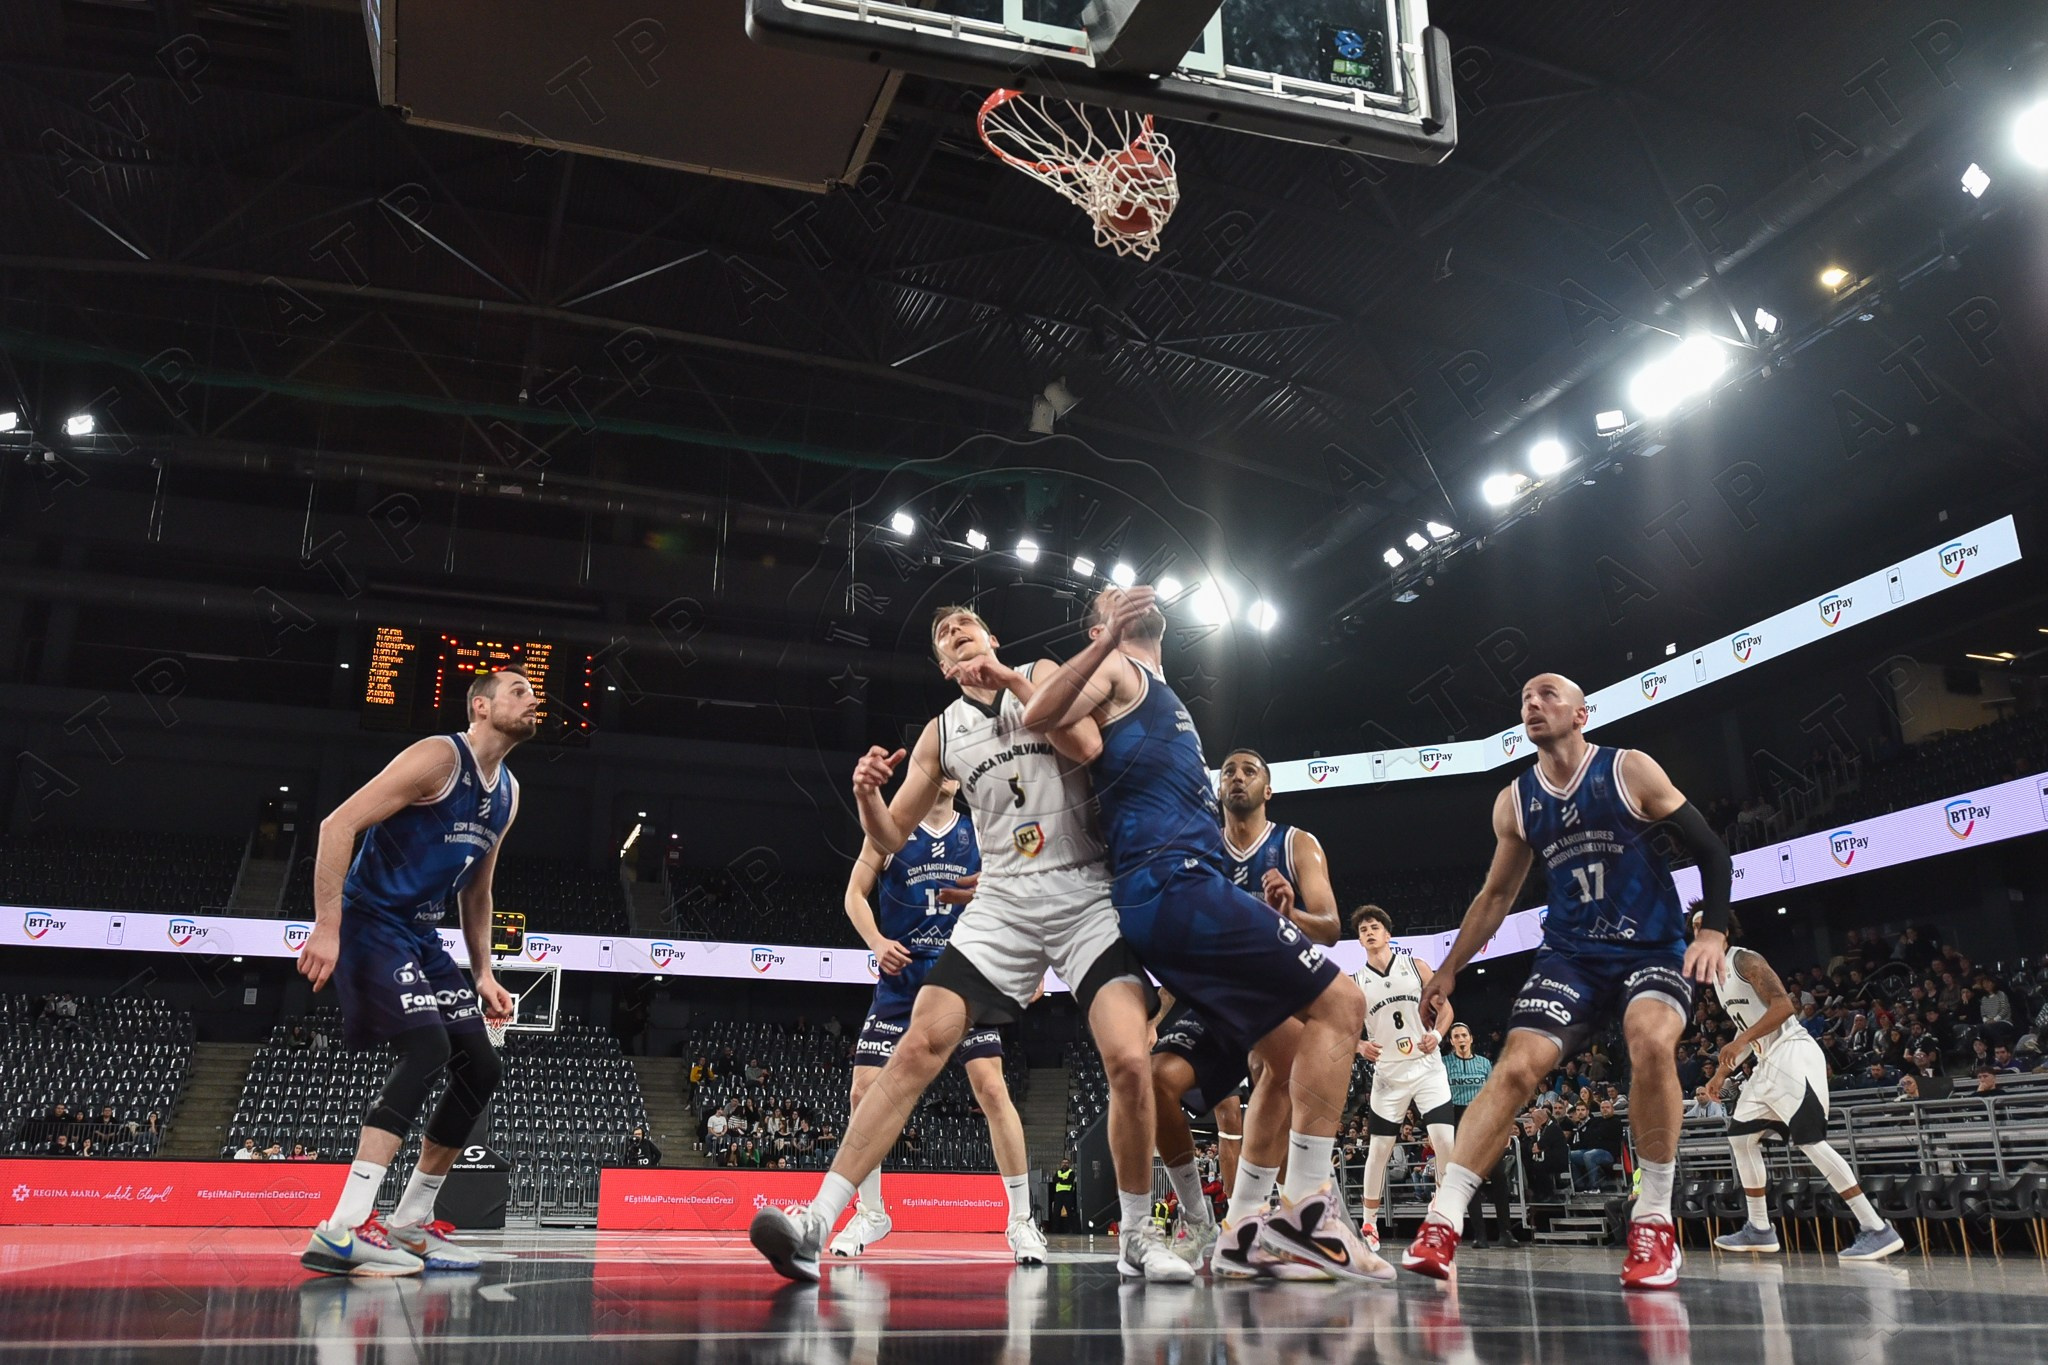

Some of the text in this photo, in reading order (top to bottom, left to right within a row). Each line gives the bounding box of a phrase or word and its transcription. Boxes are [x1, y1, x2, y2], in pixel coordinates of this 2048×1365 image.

[1330, 73, 1376, 90] EuroCup
[1585, 704, 1598, 714] Pay
[1018, 829, 1038, 846] BT
[907, 866, 922, 876] CSM
[1571, 862, 1605, 903] 17
[1392, 1010, 1404, 1030] 8
[32, 1188, 68, 1198] REGINA
[70, 1190, 100, 1198] MARIA
